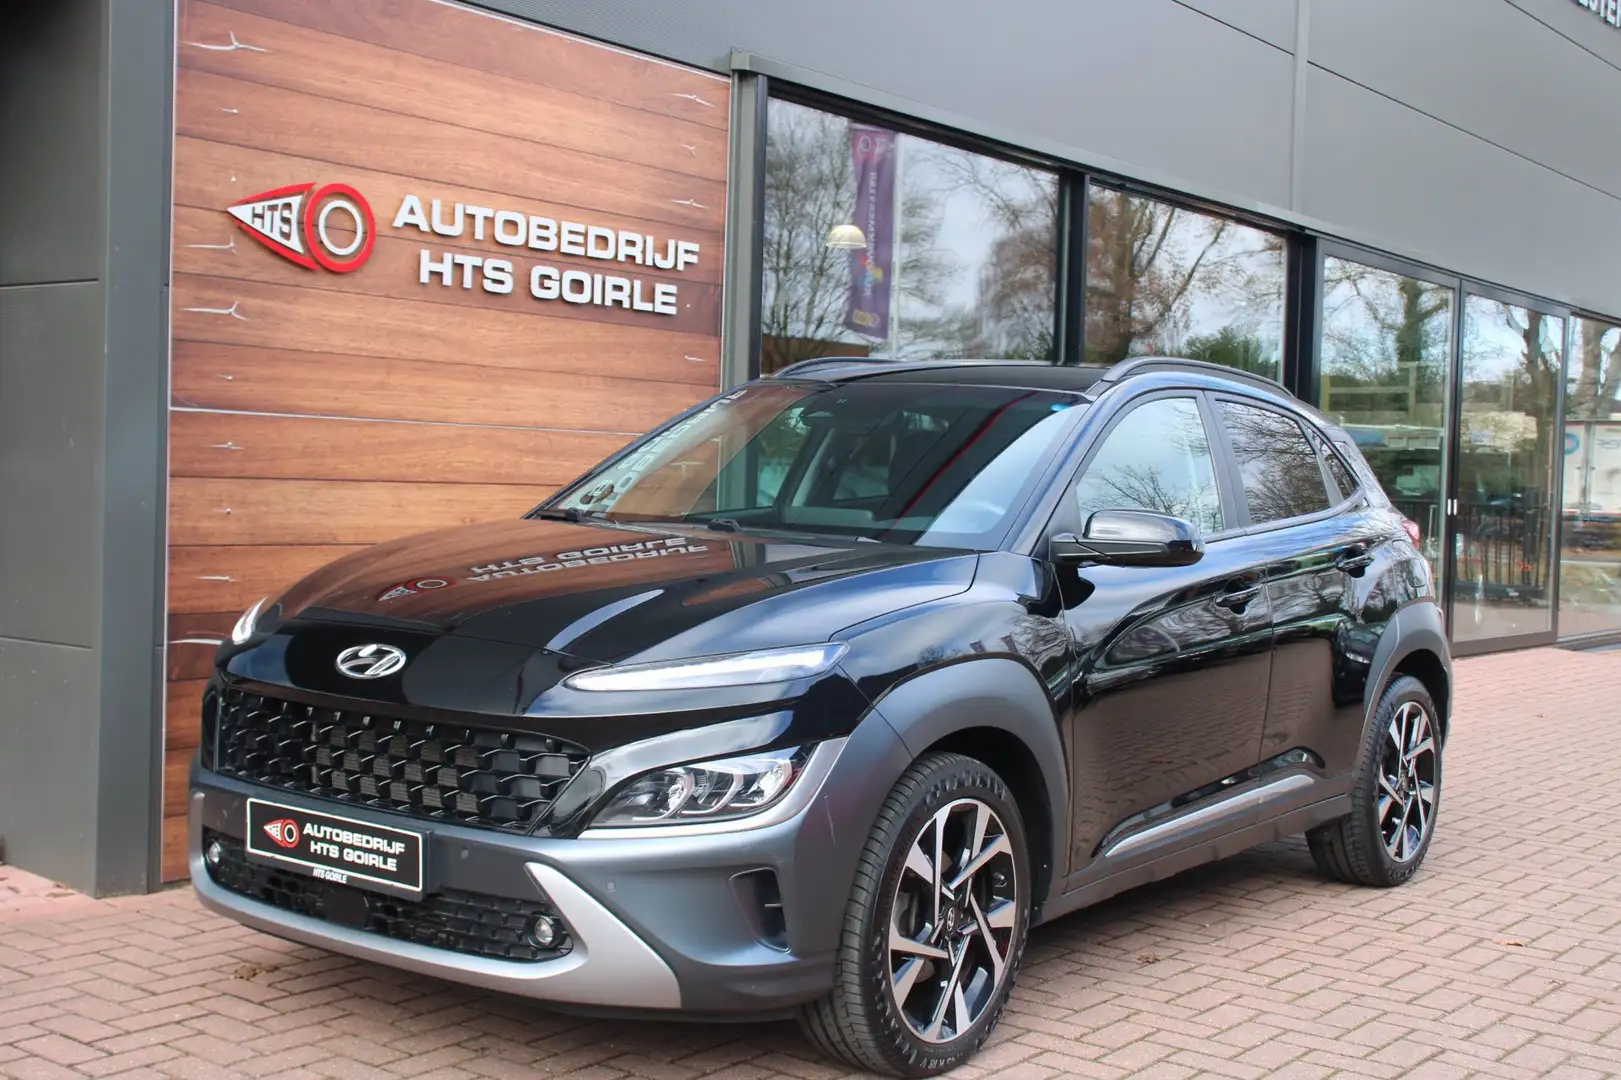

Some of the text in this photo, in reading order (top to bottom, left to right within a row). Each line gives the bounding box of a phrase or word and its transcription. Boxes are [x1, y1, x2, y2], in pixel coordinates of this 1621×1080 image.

[252, 202, 293, 242] HTS
[392, 194, 700, 272] AUTOBEDRIJF
[418, 248, 678, 316] HTS GOIRLE
[302, 822, 406, 855] AUTOBEDRIJF
[310, 841, 398, 872] HTS GOIRLE
